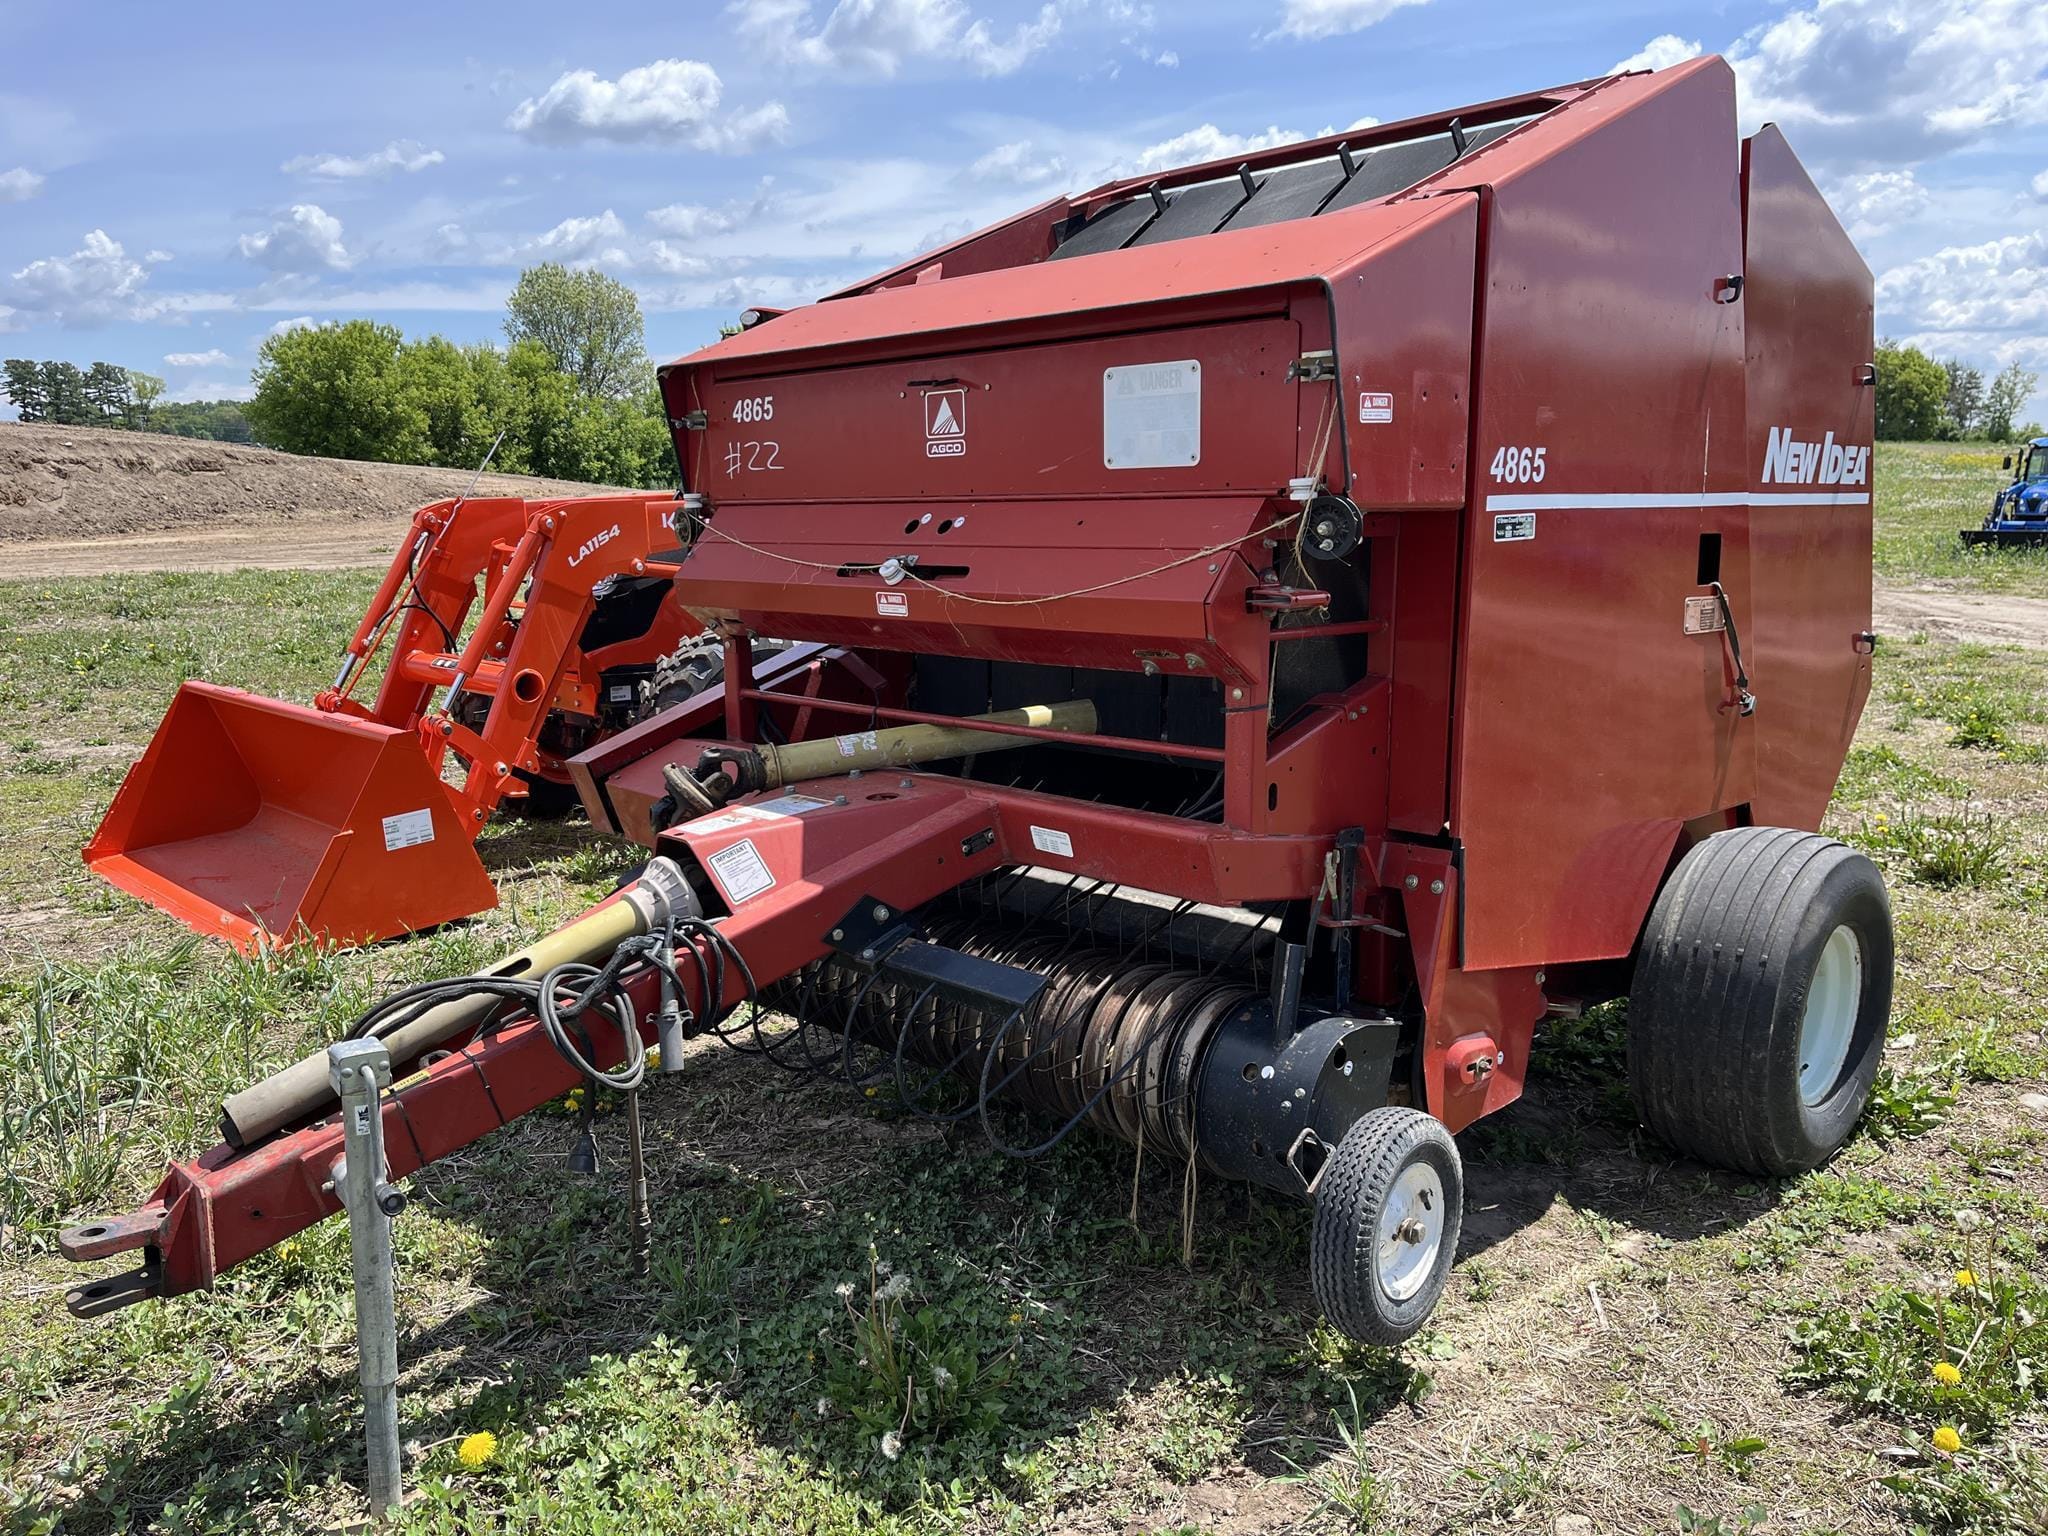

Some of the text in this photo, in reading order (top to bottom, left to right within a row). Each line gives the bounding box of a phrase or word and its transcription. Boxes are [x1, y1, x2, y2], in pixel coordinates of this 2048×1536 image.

[1139, 368, 1182, 391] DANGER
[733, 396, 773, 423] 4865
[724, 441, 785, 480] #22
[931, 443, 962, 454] AGCO
[1490, 446, 1546, 483] 4865
[568, 524, 620, 567] LA1154
[714, 844, 748, 864] IMPORTANT
